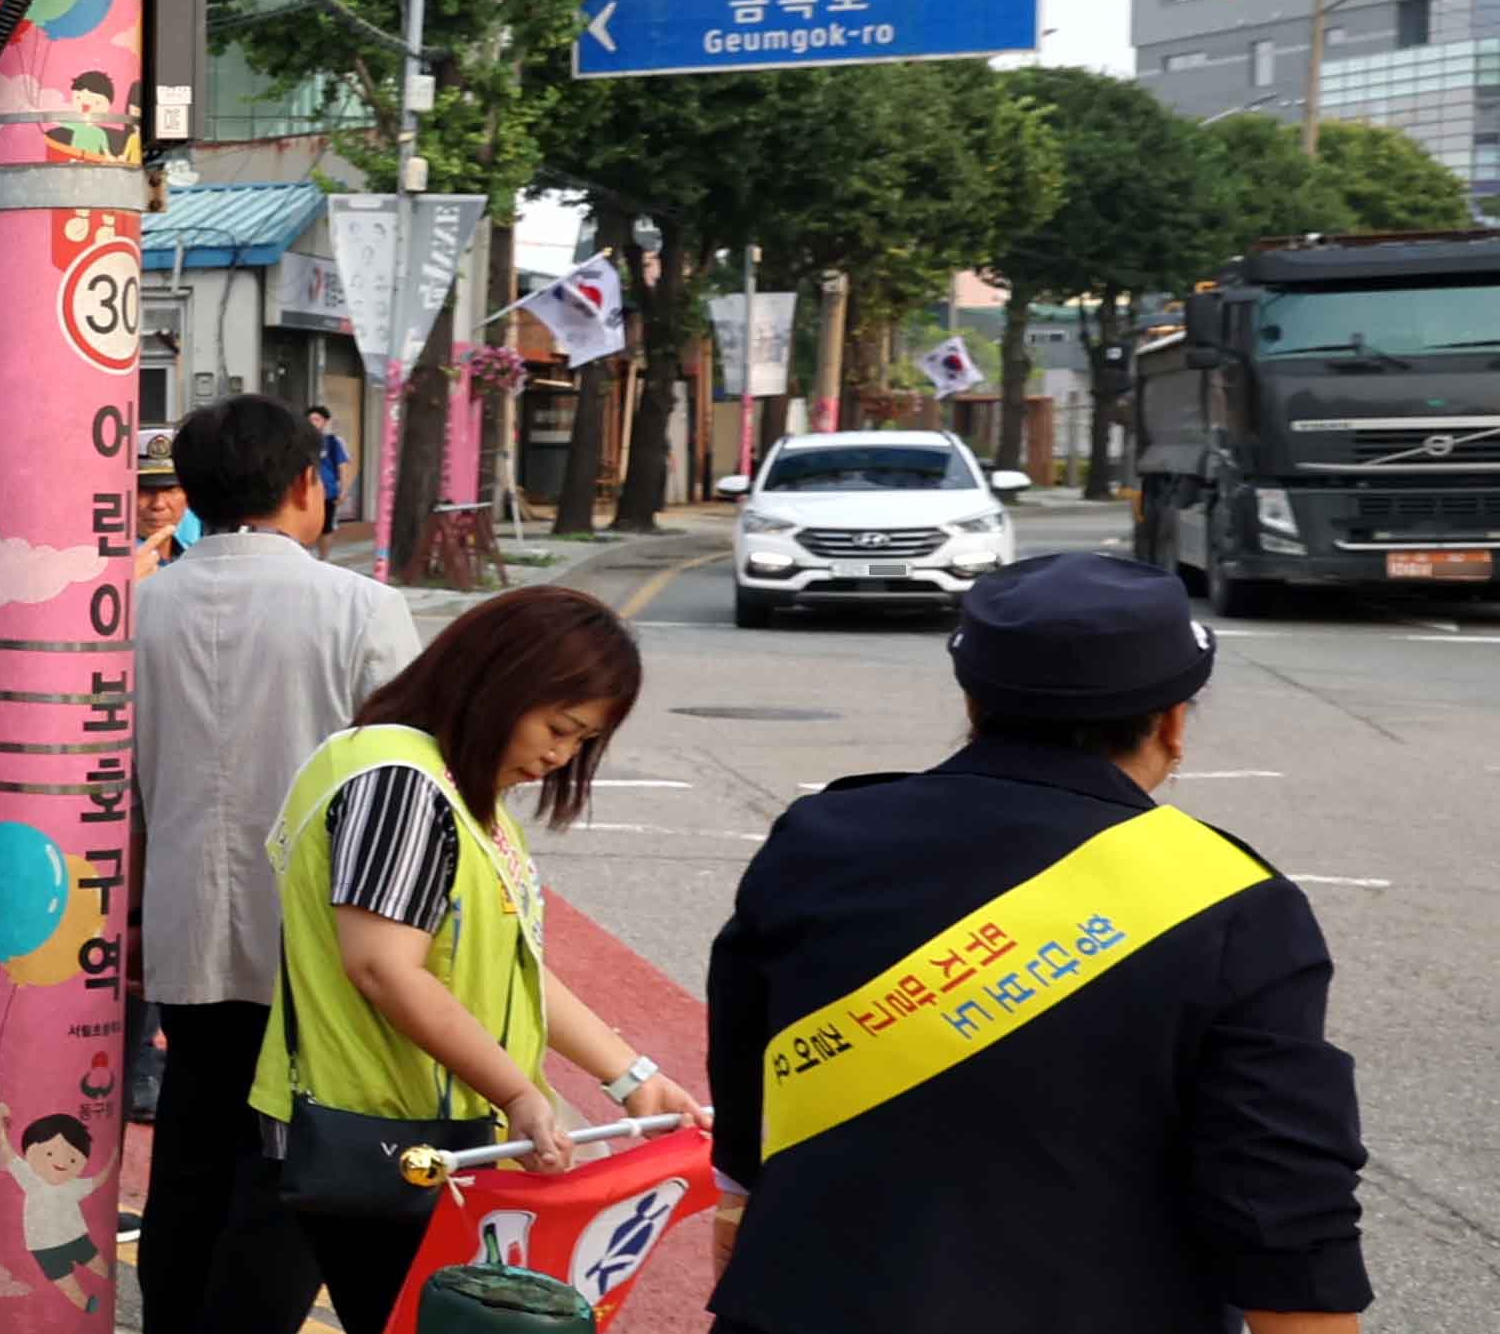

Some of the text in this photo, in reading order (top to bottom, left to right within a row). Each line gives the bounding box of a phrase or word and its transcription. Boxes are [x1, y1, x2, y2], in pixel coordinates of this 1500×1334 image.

[704, 22, 895, 55] Geumgok-ro
[86, 274, 139, 336] 30
[943, 913, 1125, 1040] 횡단보도
